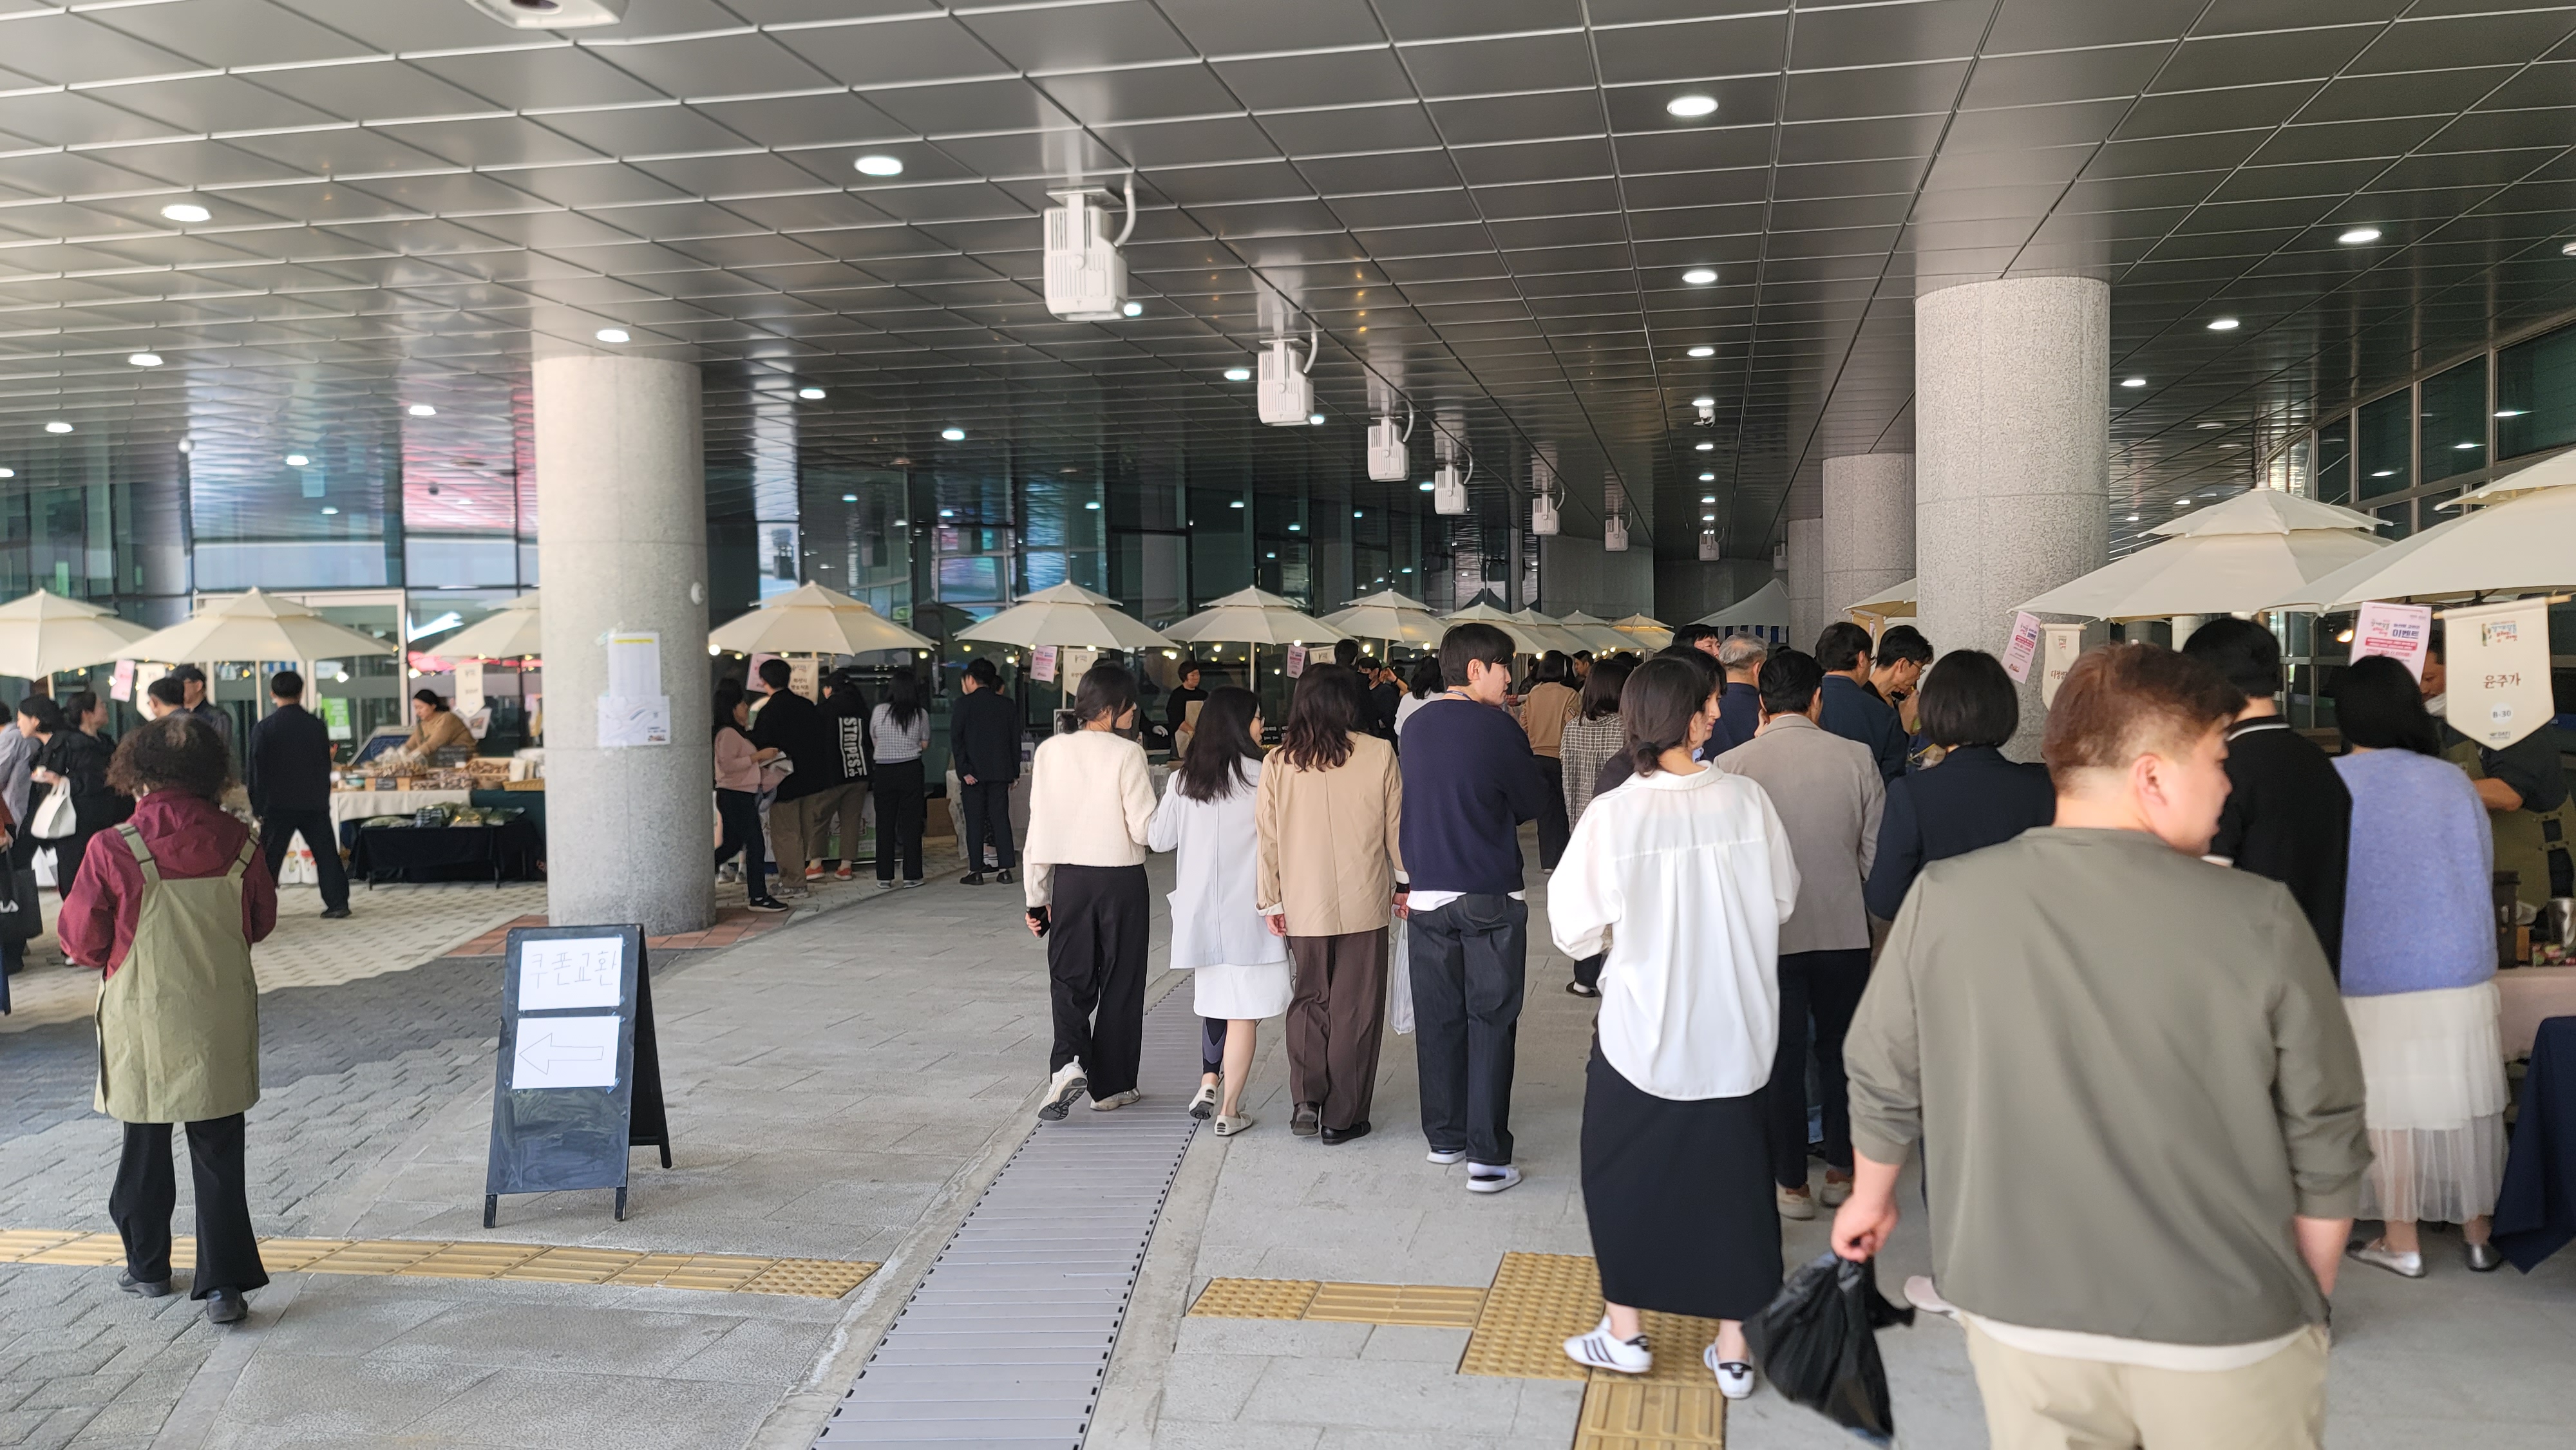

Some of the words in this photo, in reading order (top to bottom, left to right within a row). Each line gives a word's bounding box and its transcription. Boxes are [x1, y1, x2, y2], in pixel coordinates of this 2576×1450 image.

[2392, 629, 2420, 639] 이벤트
[2483, 672, 2521, 689] 윤주가
[2493, 710, 2512, 719] B-30
[844, 717, 862, 767] STRIPES
[0, 899, 19, 913] LA
